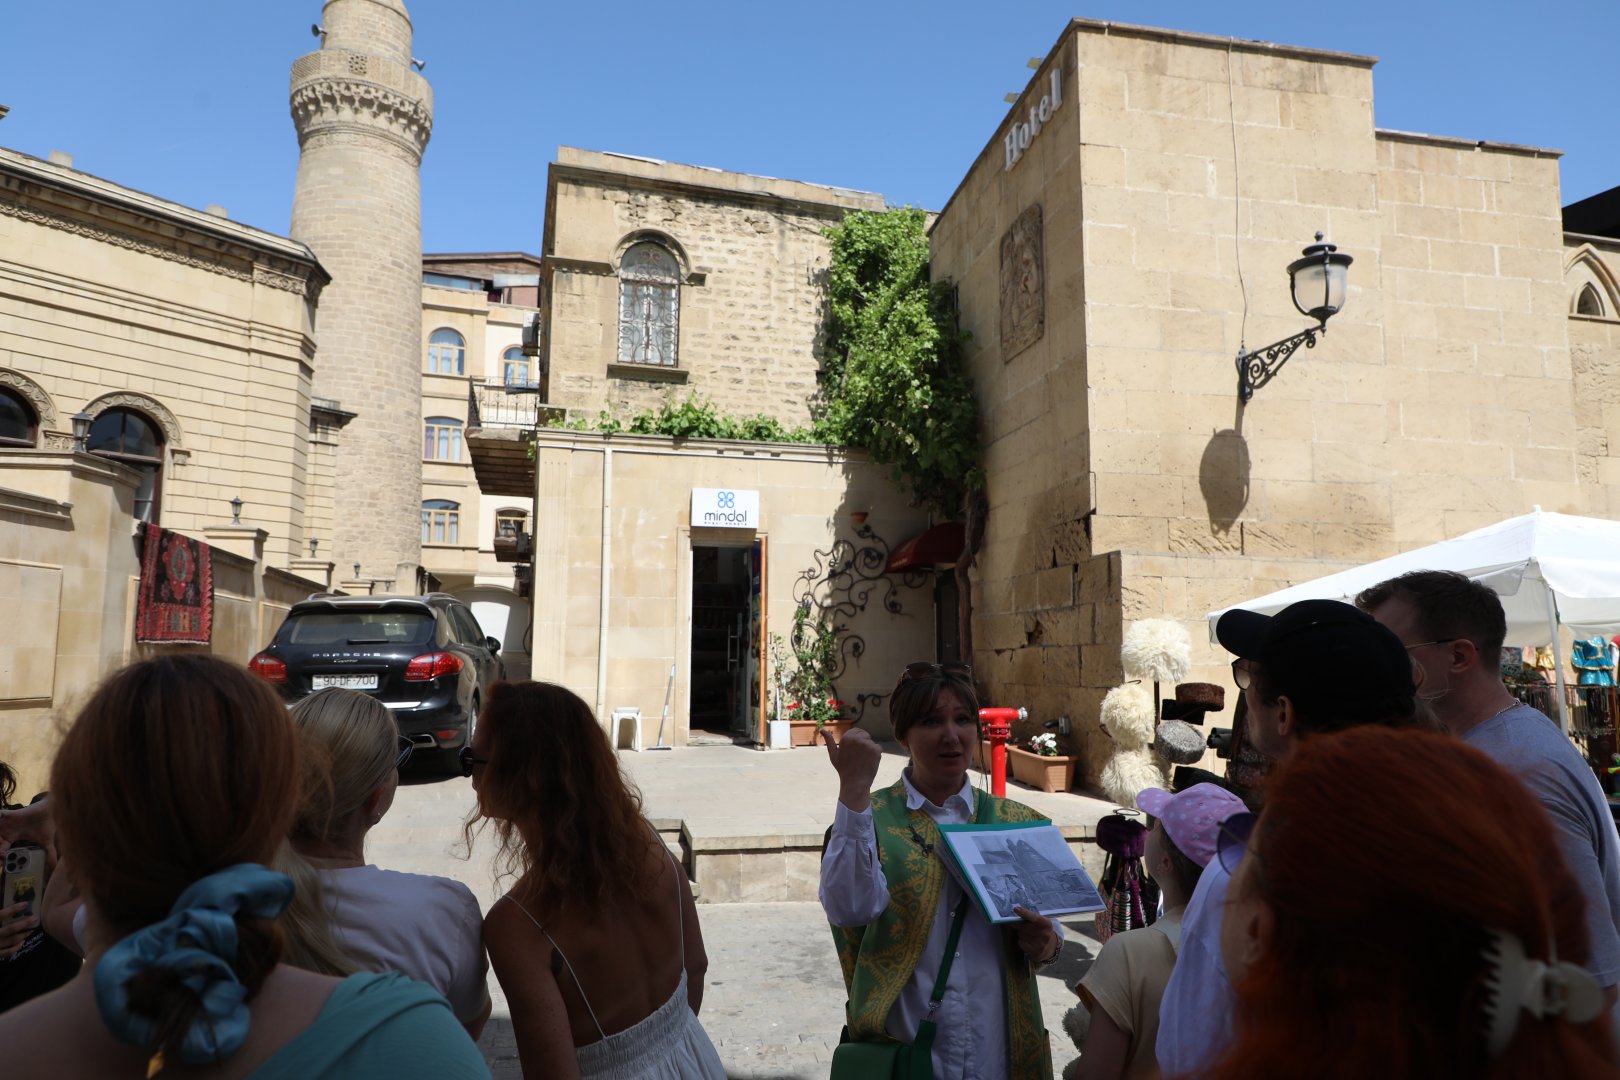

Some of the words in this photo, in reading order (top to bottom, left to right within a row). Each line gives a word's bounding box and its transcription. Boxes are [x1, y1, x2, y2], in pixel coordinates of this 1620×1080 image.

[1004, 68, 1062, 171] Hotel
[704, 509, 747, 522] mindal
[323, 675, 376, 686] 90-DF-700
